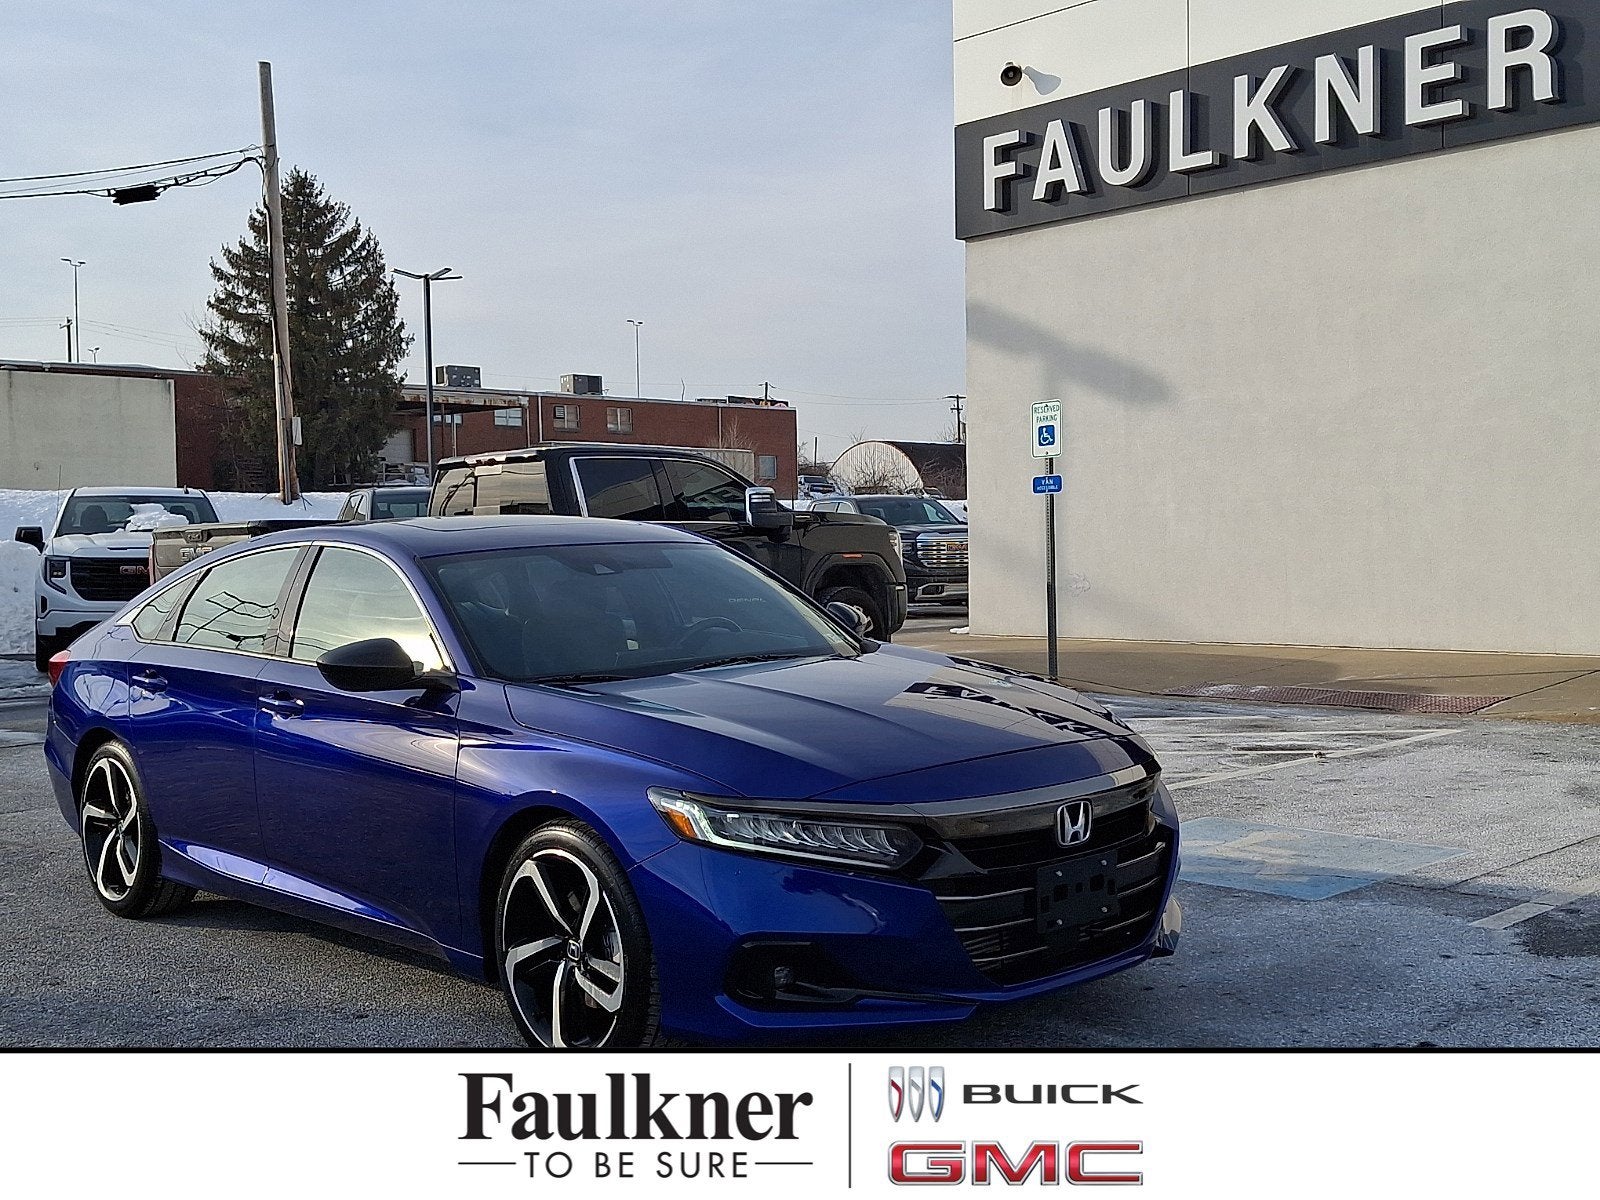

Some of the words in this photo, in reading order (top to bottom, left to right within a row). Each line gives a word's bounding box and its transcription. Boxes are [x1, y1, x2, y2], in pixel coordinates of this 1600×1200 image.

[982, 8, 1559, 212] FAULKNER
[1034, 404, 1059, 414] RESERVED
[1036, 414, 1057, 422] PARKING
[120, 565, 150, 575] GM
